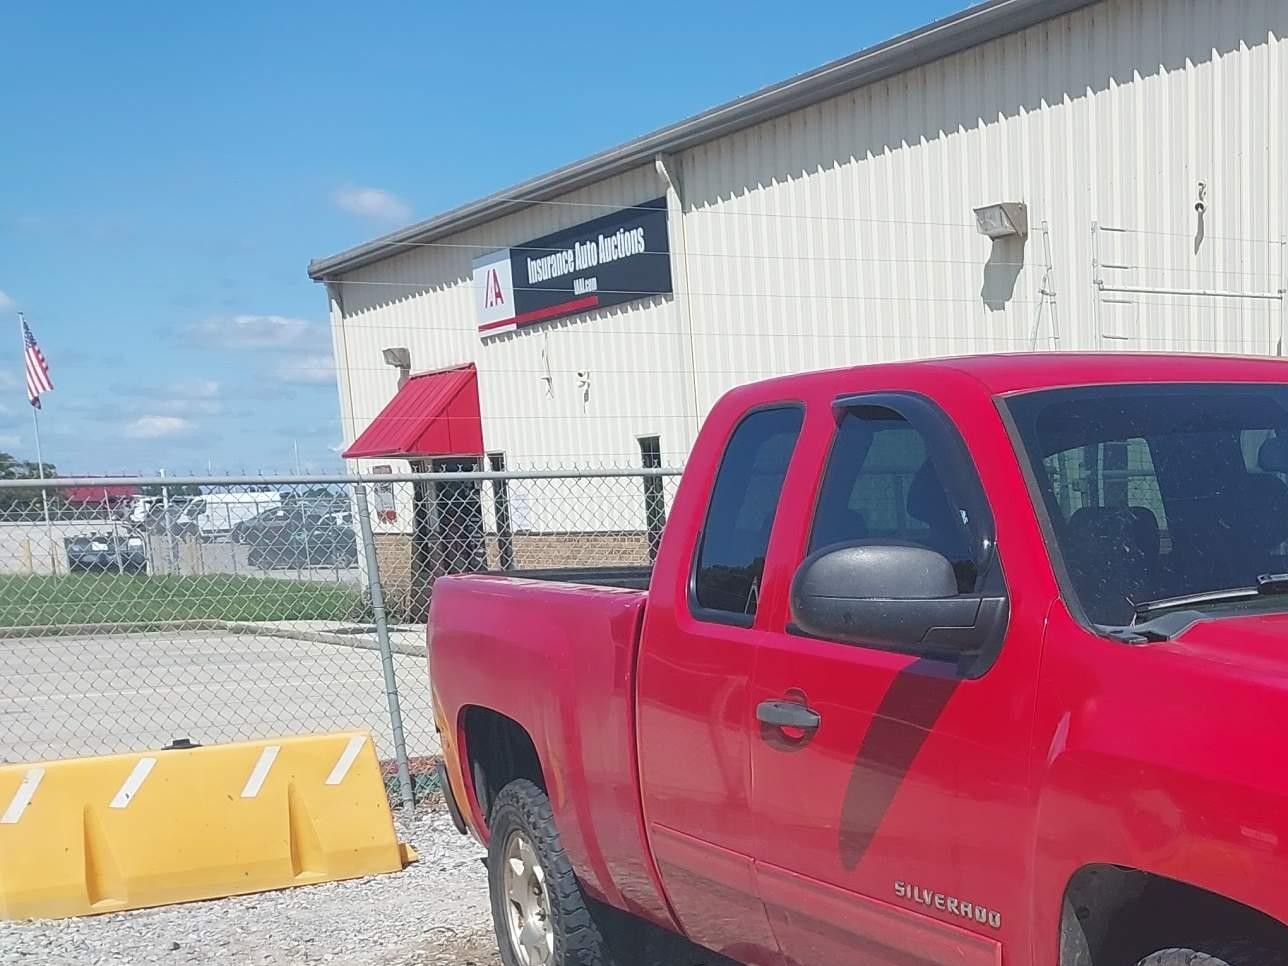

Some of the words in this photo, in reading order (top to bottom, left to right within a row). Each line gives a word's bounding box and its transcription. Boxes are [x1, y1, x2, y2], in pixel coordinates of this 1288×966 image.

[527, 248, 575, 284] Insurance
[575, 240, 598, 271] Auto
[599, 226, 646, 263] Auctions
[894, 880, 1002, 928] SILVERADO
